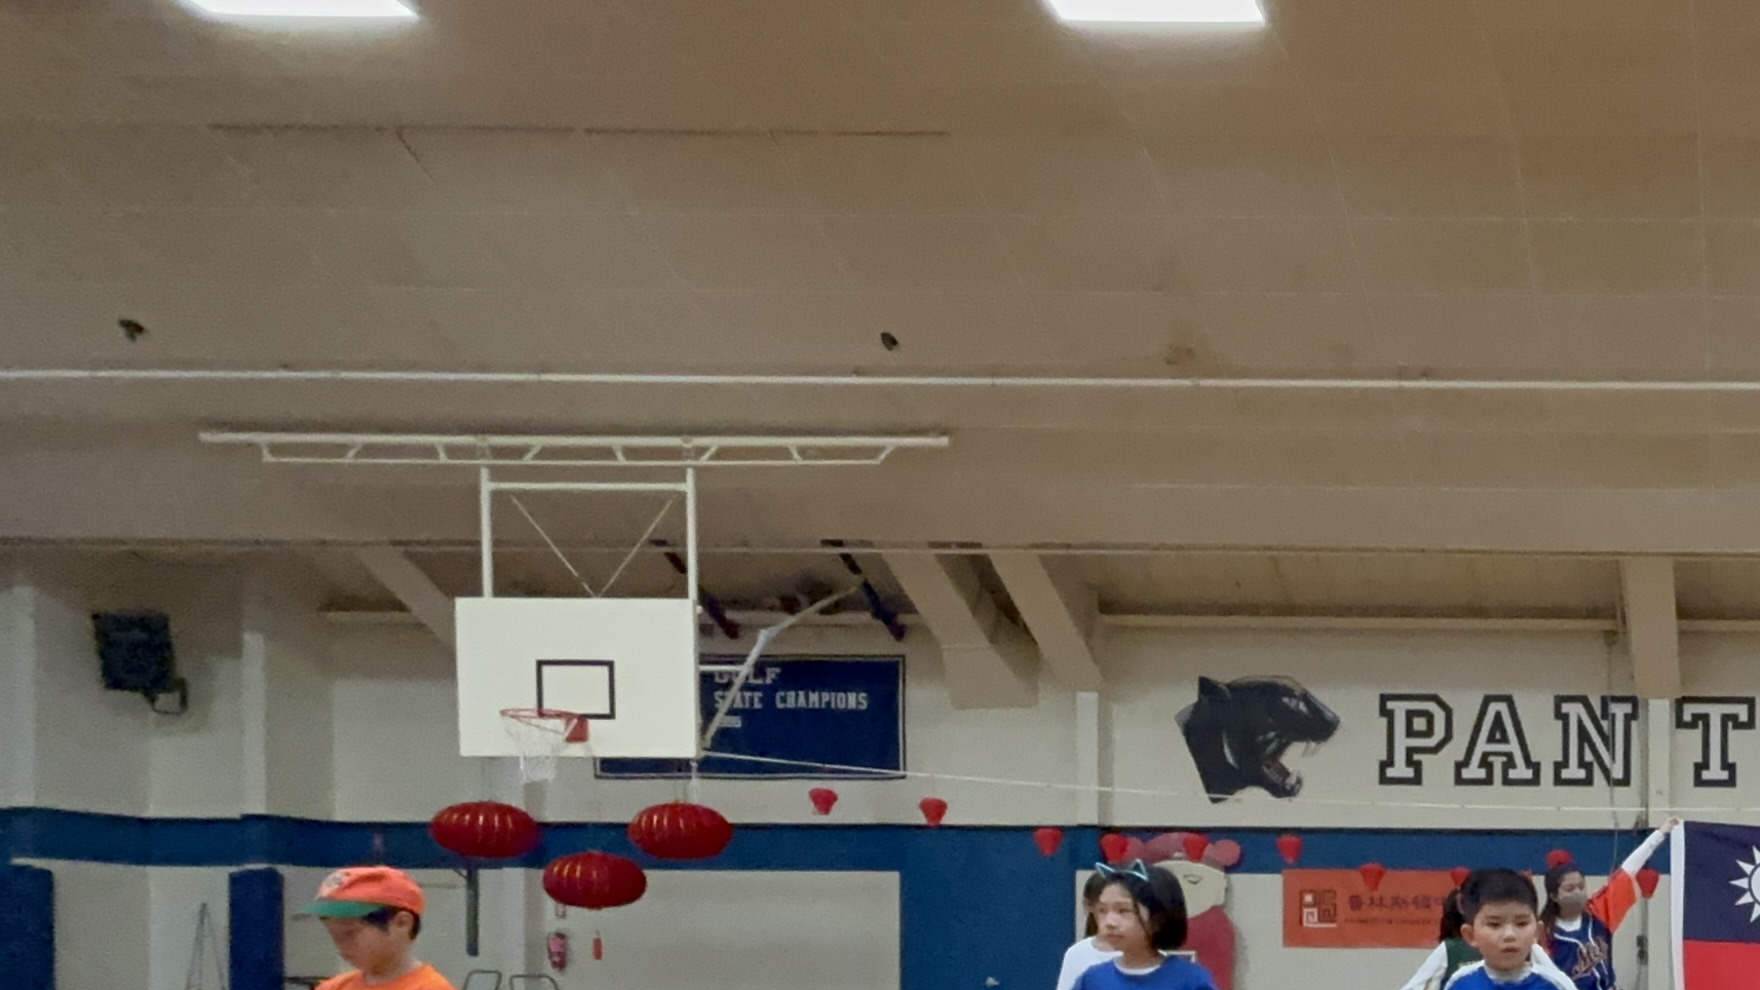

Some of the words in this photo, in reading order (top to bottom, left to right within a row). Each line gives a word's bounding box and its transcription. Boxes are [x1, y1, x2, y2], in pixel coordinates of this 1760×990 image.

[713, 667, 781, 684] GLF
[714, 691, 763, 709] SATE
[775, 690, 868, 710] CHAMPIONS
